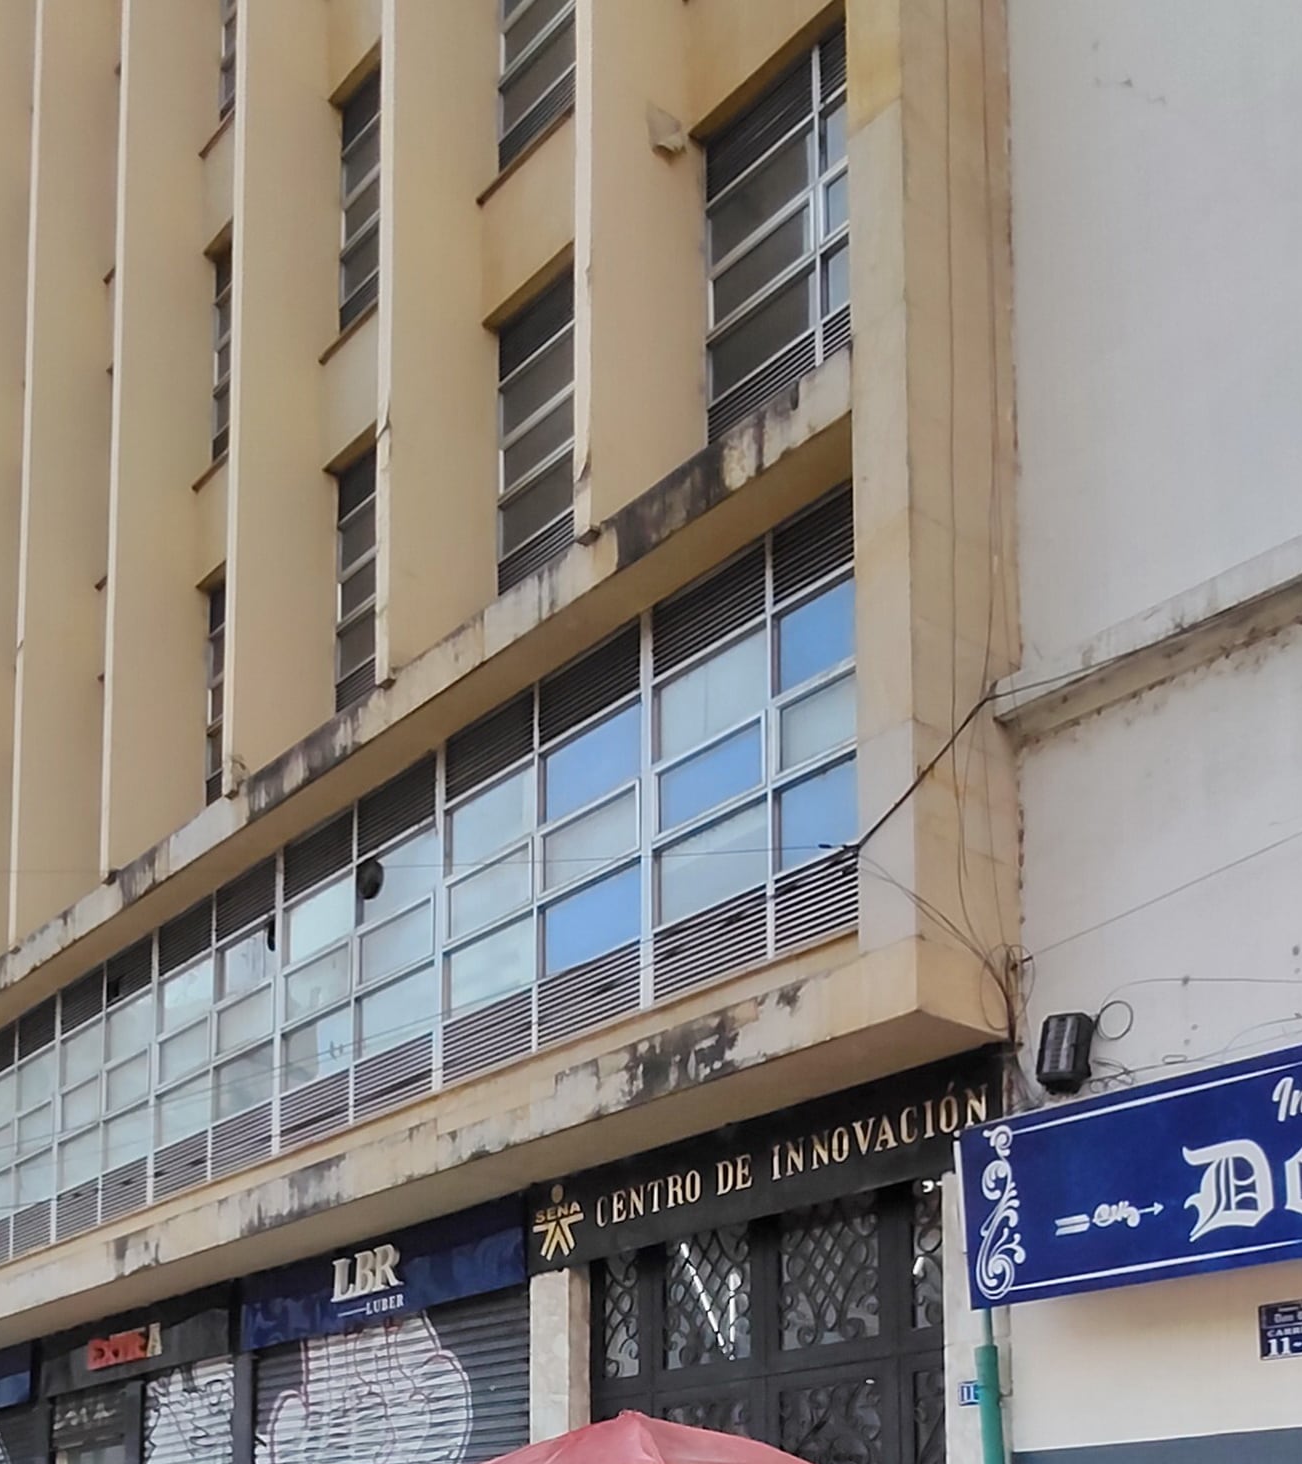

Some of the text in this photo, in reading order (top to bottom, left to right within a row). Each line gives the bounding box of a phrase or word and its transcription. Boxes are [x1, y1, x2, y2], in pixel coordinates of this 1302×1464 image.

[595, 1081, 989, 1228] CENTRO DE INNOVACIÓN
[535, 1201, 581, 1223] SENA
[330, 1244, 404, 1303] LBR
[365, 1293, 404, 1315] LUBER
